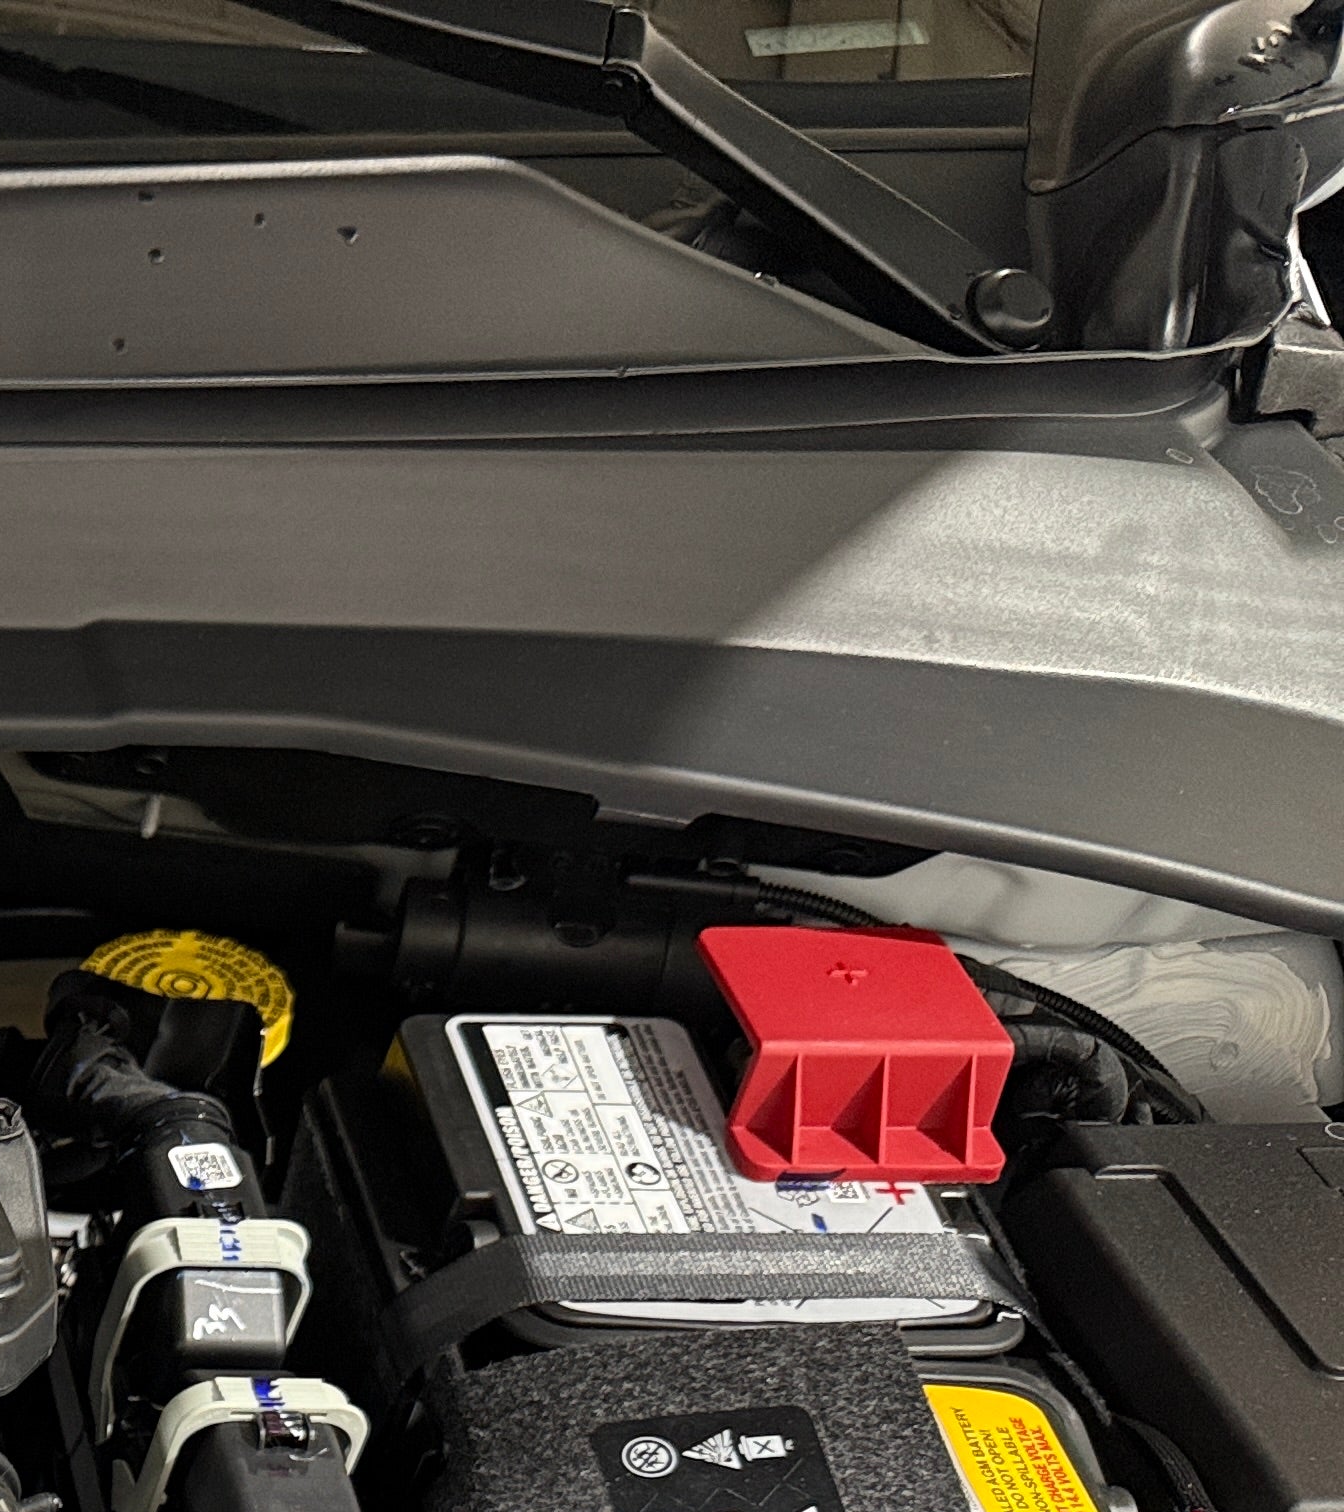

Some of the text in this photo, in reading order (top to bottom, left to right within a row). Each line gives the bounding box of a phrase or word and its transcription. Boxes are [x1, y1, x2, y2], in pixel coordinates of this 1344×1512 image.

[494, 1105, 553, 1214] DANGER/POISON
[951, 1407, 986, 1458] BATTERY
[1009, 1416, 1043, 1463] VOLTAGE
[976, 1459, 1000, 1486] AGM
[996, 1467, 1017, 1491] NOT
[1031, 1463, 1066, 1504] CHARGE
[1043, 1452, 1072, 1486] VOLTS
[1011, 1492, 1030, 1510] DO
